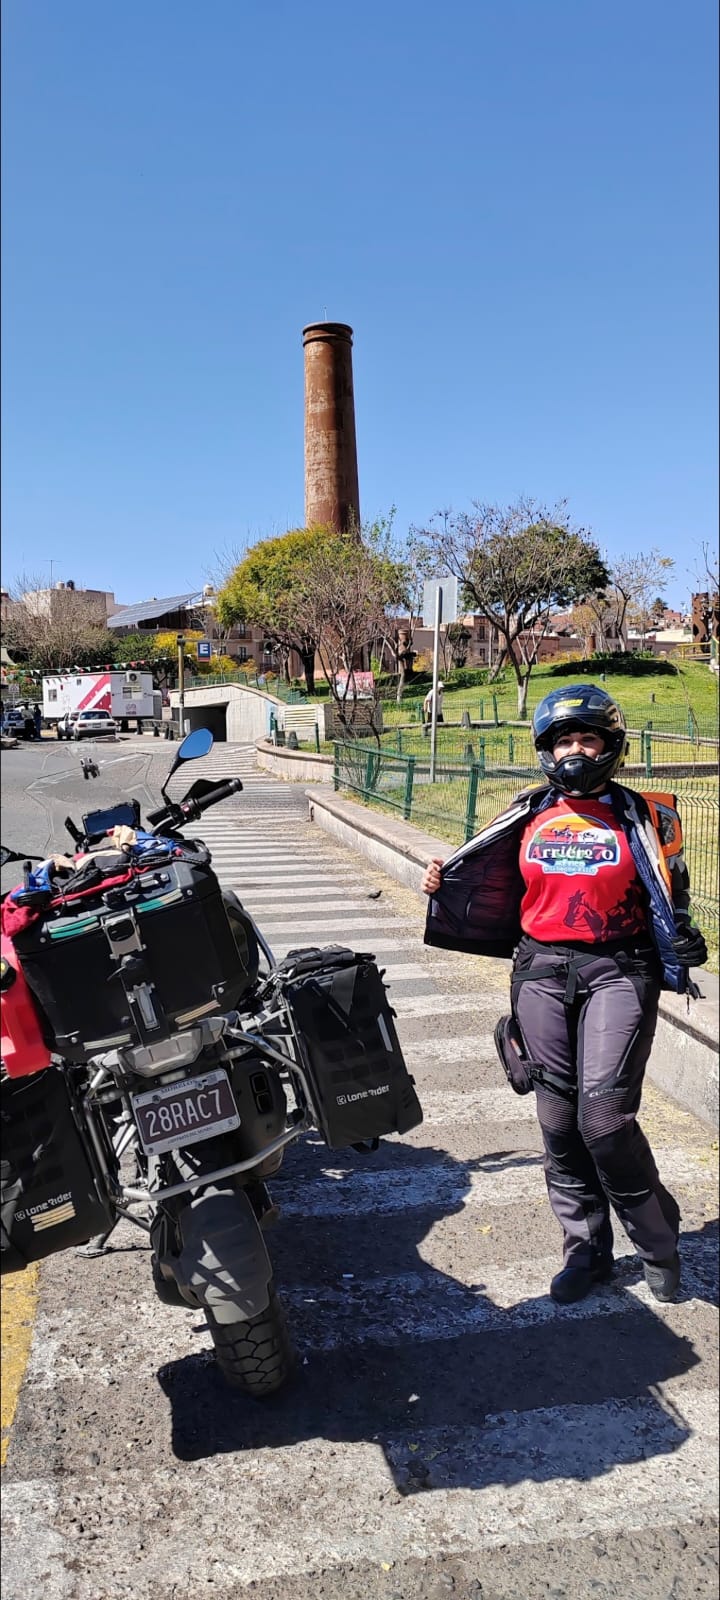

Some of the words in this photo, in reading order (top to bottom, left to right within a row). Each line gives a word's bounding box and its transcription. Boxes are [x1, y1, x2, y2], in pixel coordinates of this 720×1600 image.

[199, 643, 209, 654] E
[346, 1091, 368, 1102] Lone
[145, 1089, 222, 1137] 28RAC7
[25, 1202, 48, 1216] Lone
